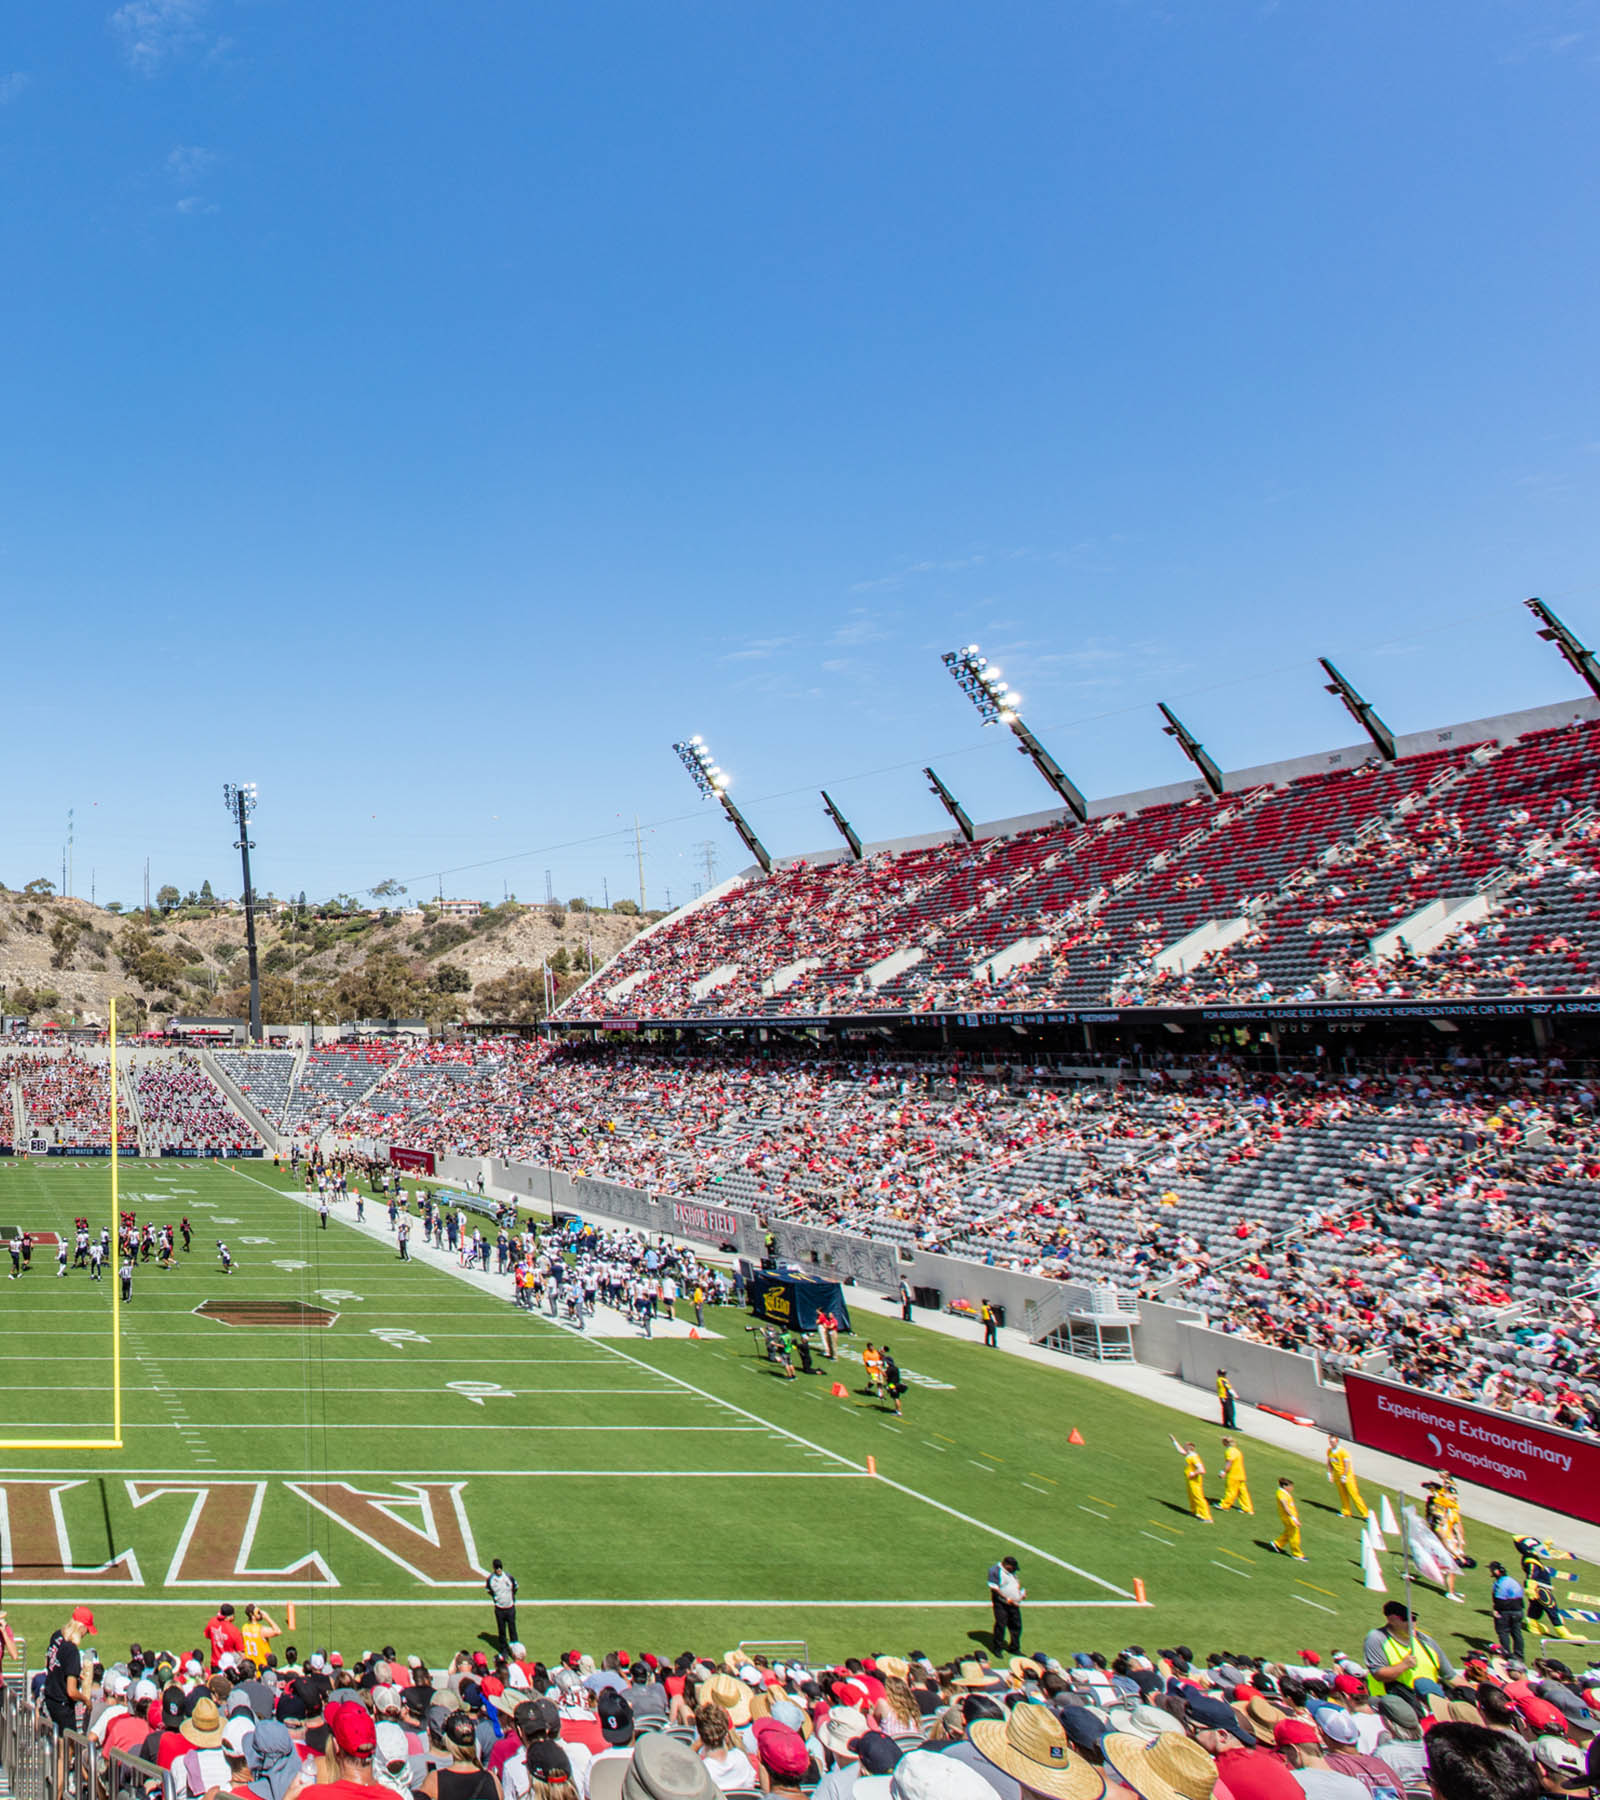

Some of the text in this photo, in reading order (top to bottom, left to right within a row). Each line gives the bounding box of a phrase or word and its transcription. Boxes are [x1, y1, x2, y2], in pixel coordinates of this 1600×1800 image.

[1203, 1011, 1218, 1020] FOR
[1268, 1010, 1298, 1018] PLEASE
[1299, 1009, 1316, 1017] SEE
[1322, 1008, 1351, 1017] GUEST
[1353, 1007, 1393, 1017] SERVICE
[1393, 1006, 1478, 1016] REPRESENTATIVE
[1479, 1006, 1497, 1015] OR
[1497, 1005, 1526, 1014] TEXT
[1556, 1004, 1566, 1013] A
[31, 1141, 46, 1150] 38
[31, 1161, 210, 1170] STATE
[673, 1203, 737, 1235] BASHOR FIELD
[1377, 1395, 1573, 1472] Experience Extraordinary
[1447, 1443, 1527, 1481] Snapdragon
